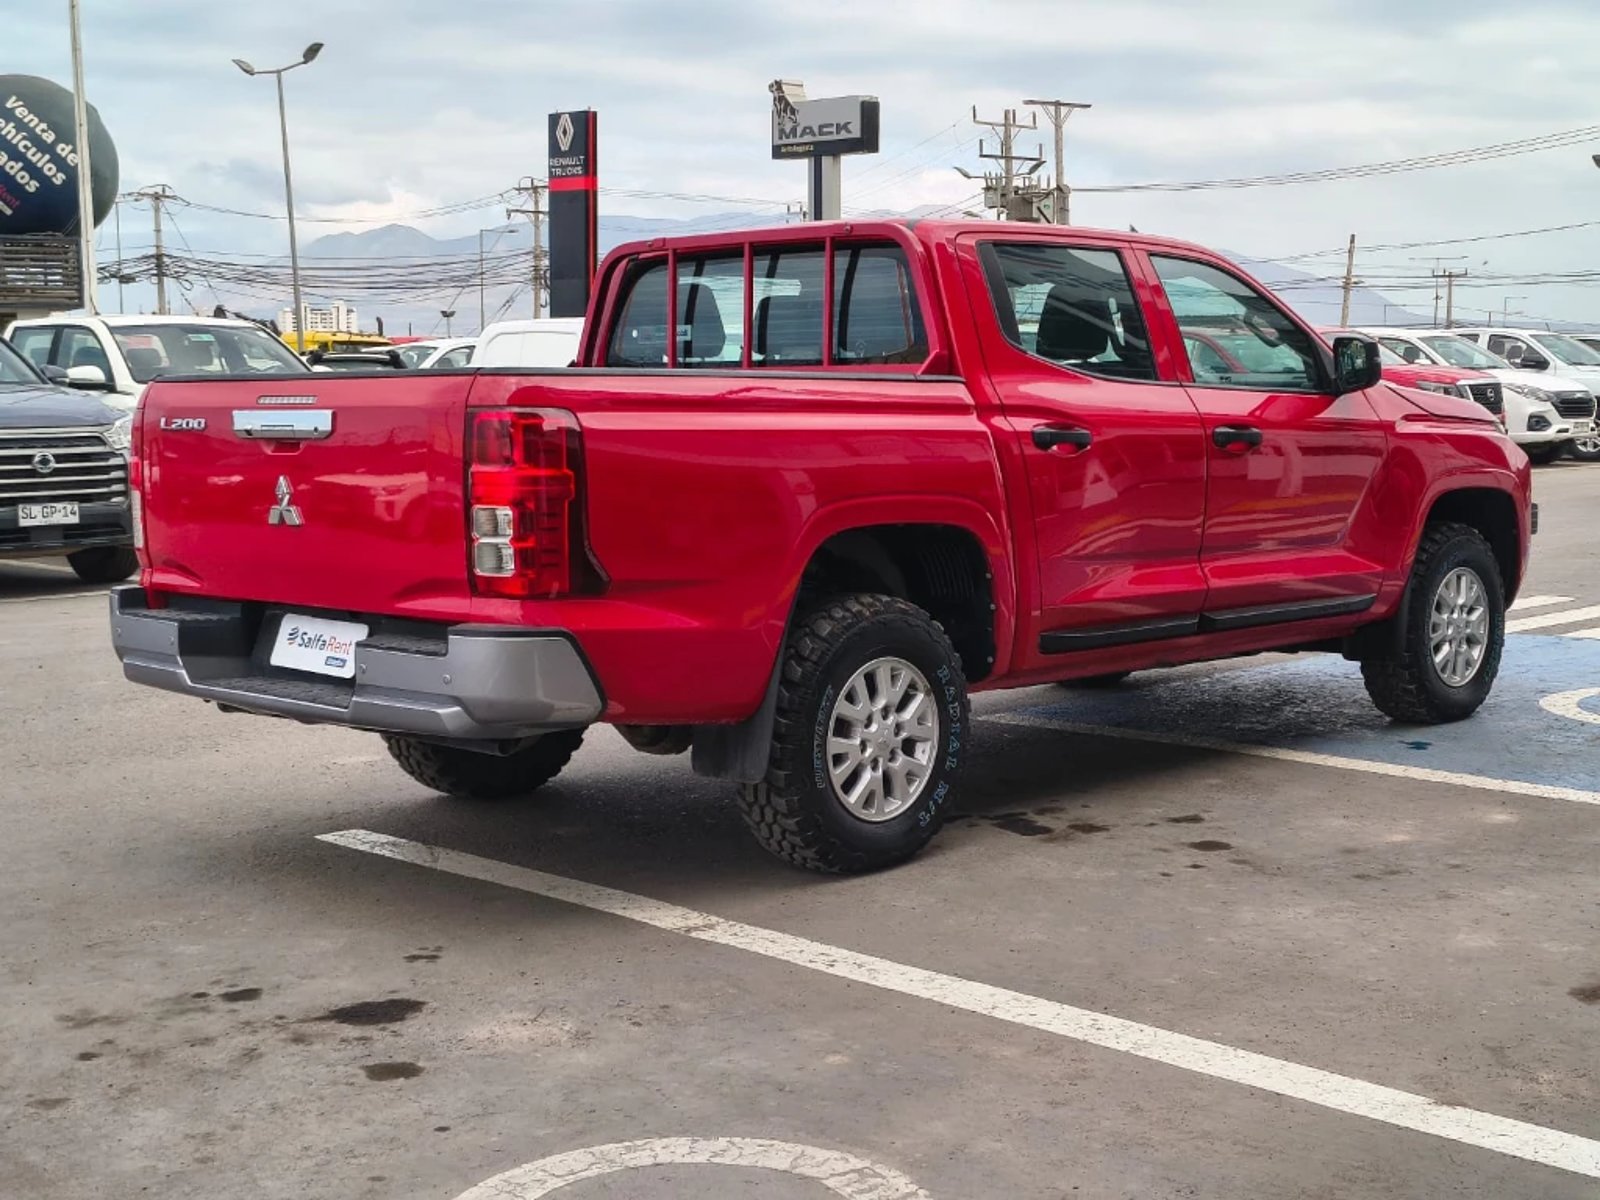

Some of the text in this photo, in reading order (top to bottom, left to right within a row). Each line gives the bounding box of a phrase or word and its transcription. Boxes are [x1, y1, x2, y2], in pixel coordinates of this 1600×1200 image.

[5, 95, 78, 167] Venta de
[778, 121, 853, 140] MACK
[159, 416, 208, 431] L200
[297, 631, 353, 656] SalfaRent
